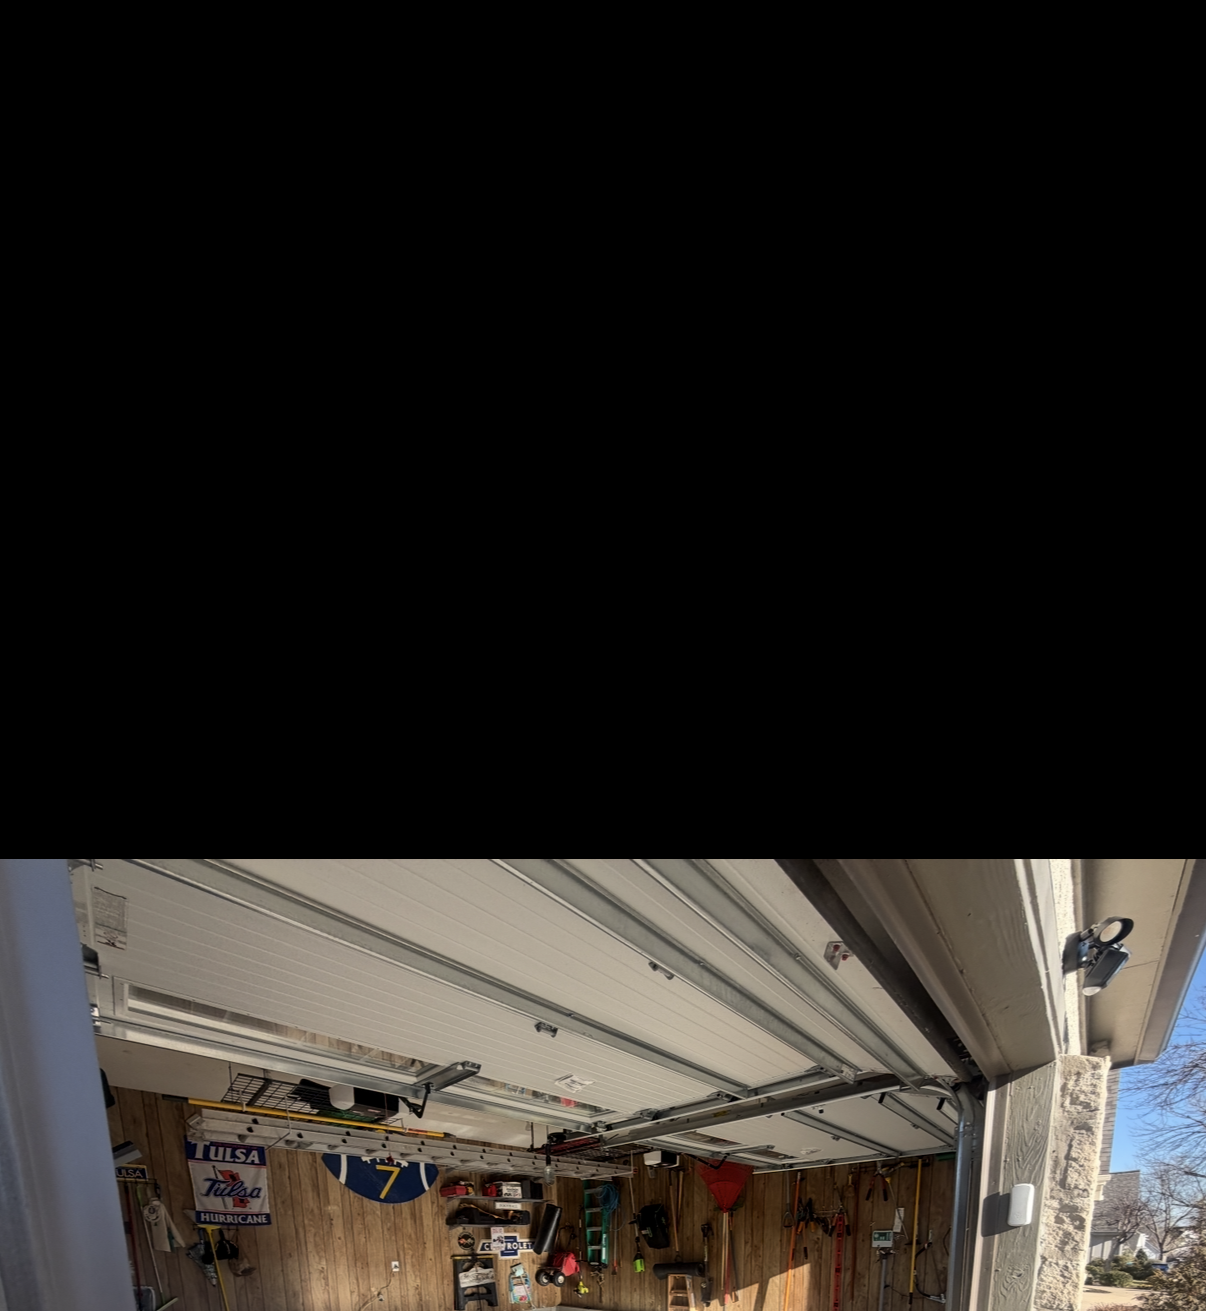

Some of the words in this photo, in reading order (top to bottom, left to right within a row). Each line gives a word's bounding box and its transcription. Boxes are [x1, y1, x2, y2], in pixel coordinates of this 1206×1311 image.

[191, 1140, 260, 1164] TULSA
[116, 1168, 143, 1178] ULSA
[201, 1178, 262, 1198] Tulsa
[375, 1164, 401, 1199] 7
[200, 1212, 268, 1224] HURRICANE
[484, 1242, 532, 1251] CROLET
